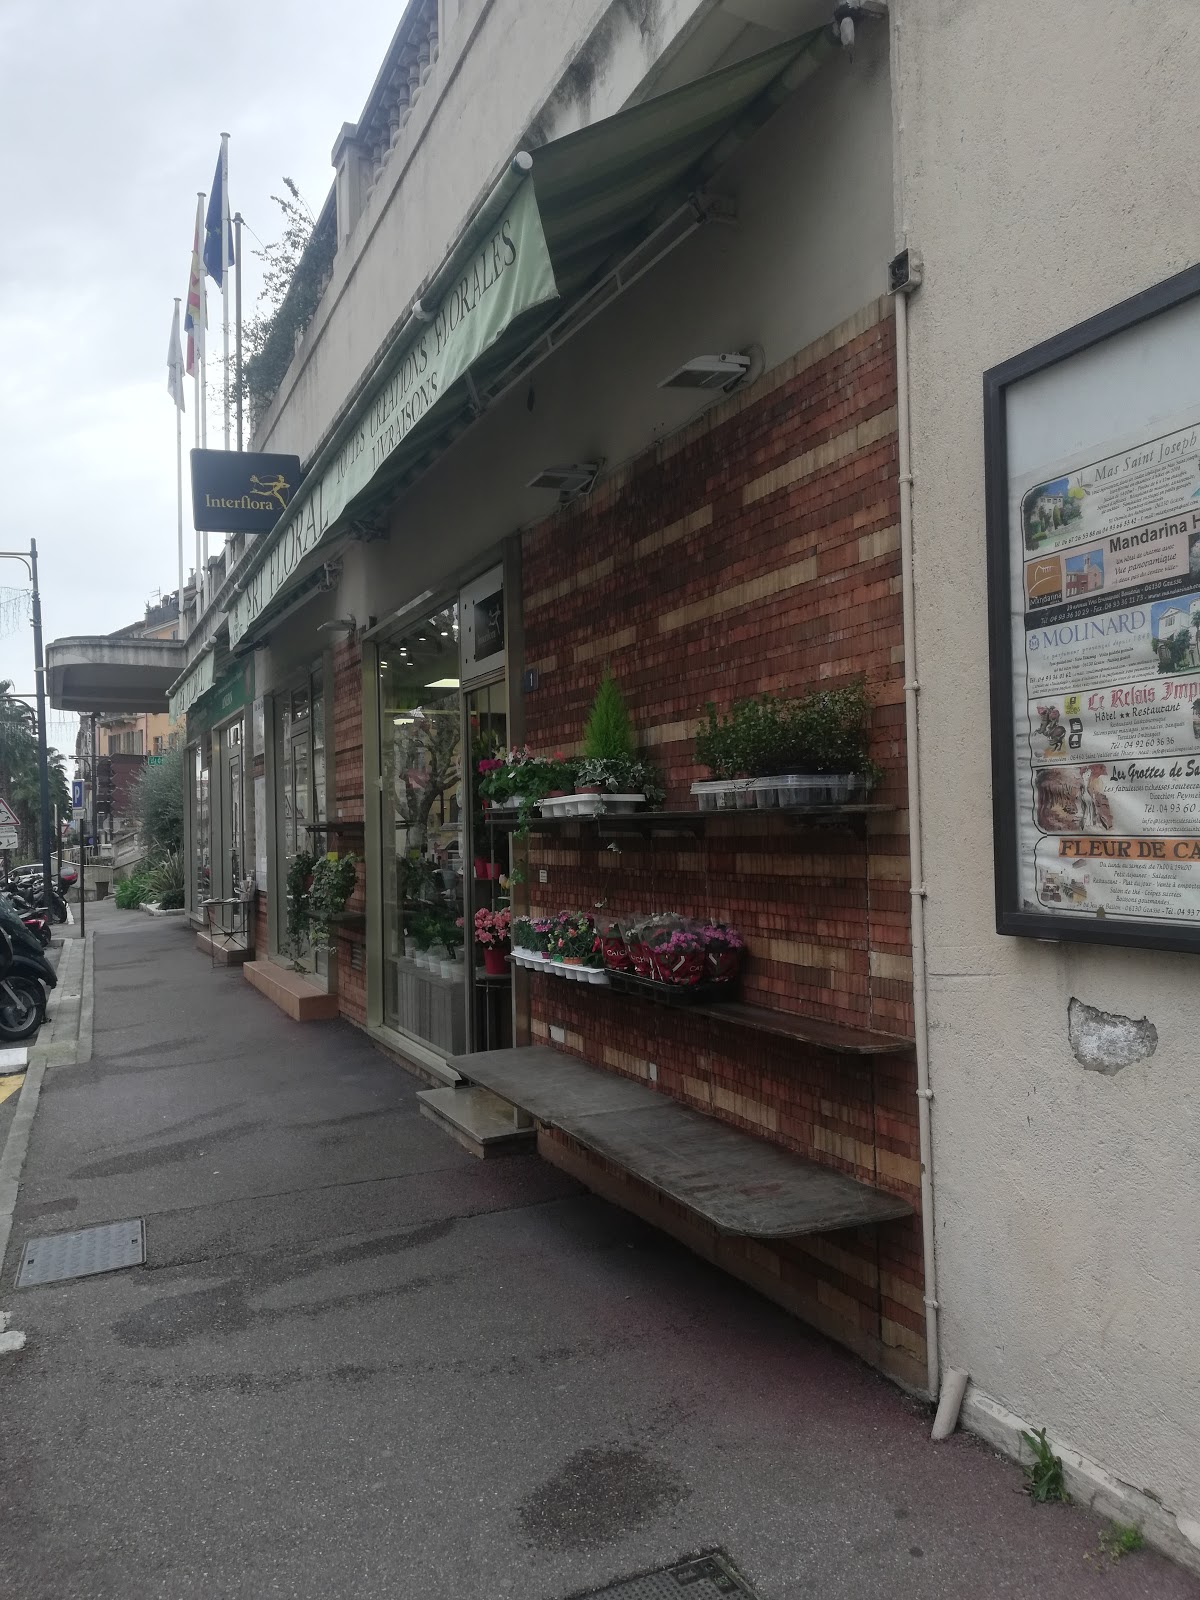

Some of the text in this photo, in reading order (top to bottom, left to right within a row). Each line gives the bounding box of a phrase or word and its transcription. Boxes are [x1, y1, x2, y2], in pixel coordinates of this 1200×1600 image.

[269, 484, 328, 599] FLORAL
[336, 424, 365, 484] TOUTES
[370, 336, 428, 437] CREATIONS
[434, 219, 516, 357] FLORALES
[372, 371, 437, 471] LIVRAISONS
[1094, 465, 1119, 482] Mas
[1123, 450, 1154, 472] Saint
[1158, 431, 1197, 463] Joseph
[205, 494, 273, 510] Interflora
[1109, 520, 1187, 553] Mandarina
[1162, 544, 1175, 552] avec
[1115, 553, 1177, 575] Vue panoramique
[1144, 582, 1161, 592] 06130
[1162, 579, 1182, 588] Grasse
[1050, 615, 1058, 623] 04
[1058, 613, 1066, 621] 93
[1066, 611, 1074, 619] 36
[1082, 607, 1090, 616] 29
[1104, 602, 1112, 610] 04
[1112, 600, 1120, 608] 93
[1042, 610, 1146, 649] MOLINARD
[1088, 693, 1105, 712] Le
[1110, 685, 1156, 709] Relais
[1160, 681, 1200, 703] Imp
[1095, 702, 1181, 722] Hôtel Restaurant
[1123, 741, 1133, 749] 04
[1135, 739, 1144, 748] 92
[1145, 738, 1155, 747] 60
[1156, 737, 1165, 746] 36
[1166, 736, 1175, 745] 36
[1110, 765, 1126, 781] Les
[1127, 763, 1165, 783] Grottes
[1169, 761, 1183, 778] de
[74, 785, 80, 804] P
[1104, 785, 1114, 793] Les
[1149, 792, 1175, 800] Direction
[1159, 803, 1168, 813] 04
[1170, 803, 1181, 813] 93
[1182, 803, 1196, 813] 60
[1060, 840, 1132, 857] FLEUR
[1137, 841, 1167, 858] DE
[1156, 863, 1169, 871] 7h00
[1144, 889, 1161, 898] Crêpes
[1124, 905, 1142, 913] 06130
[1142, 906, 1161, 914] Grasse
[1176, 908, 1186, 916] 04
[1187, 909, 1195, 917] 93
